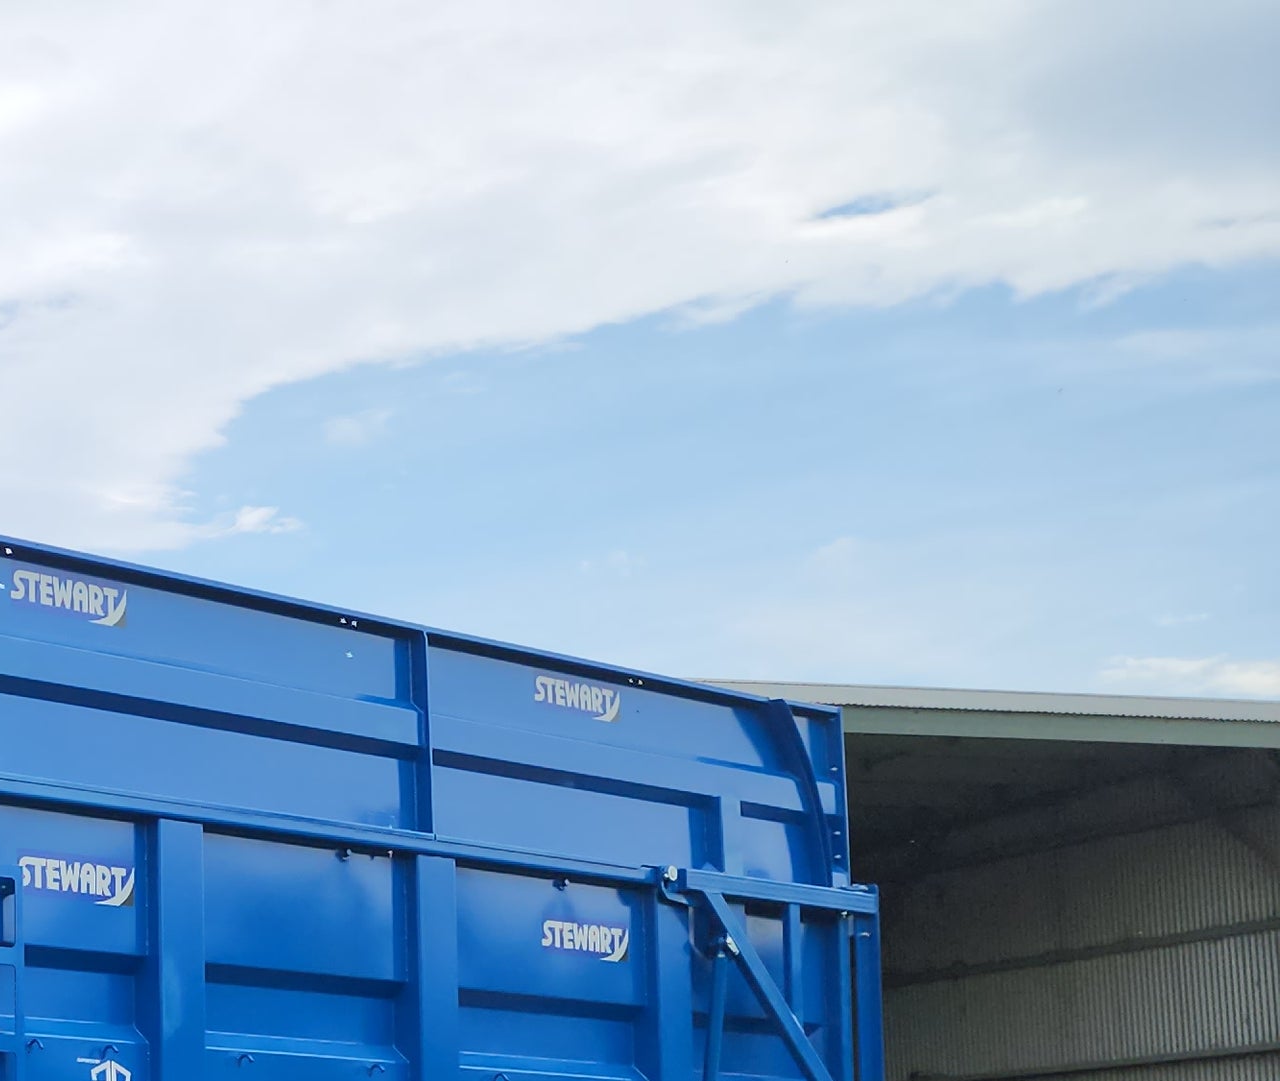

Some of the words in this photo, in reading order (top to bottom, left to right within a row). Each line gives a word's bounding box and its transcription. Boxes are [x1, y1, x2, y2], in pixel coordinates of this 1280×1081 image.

[11, 570, 127, 626] STEWART
[535, 676, 620, 722] STEWART
[19, 856, 135, 906] STEWART
[542, 920, 628, 962] STEWART
